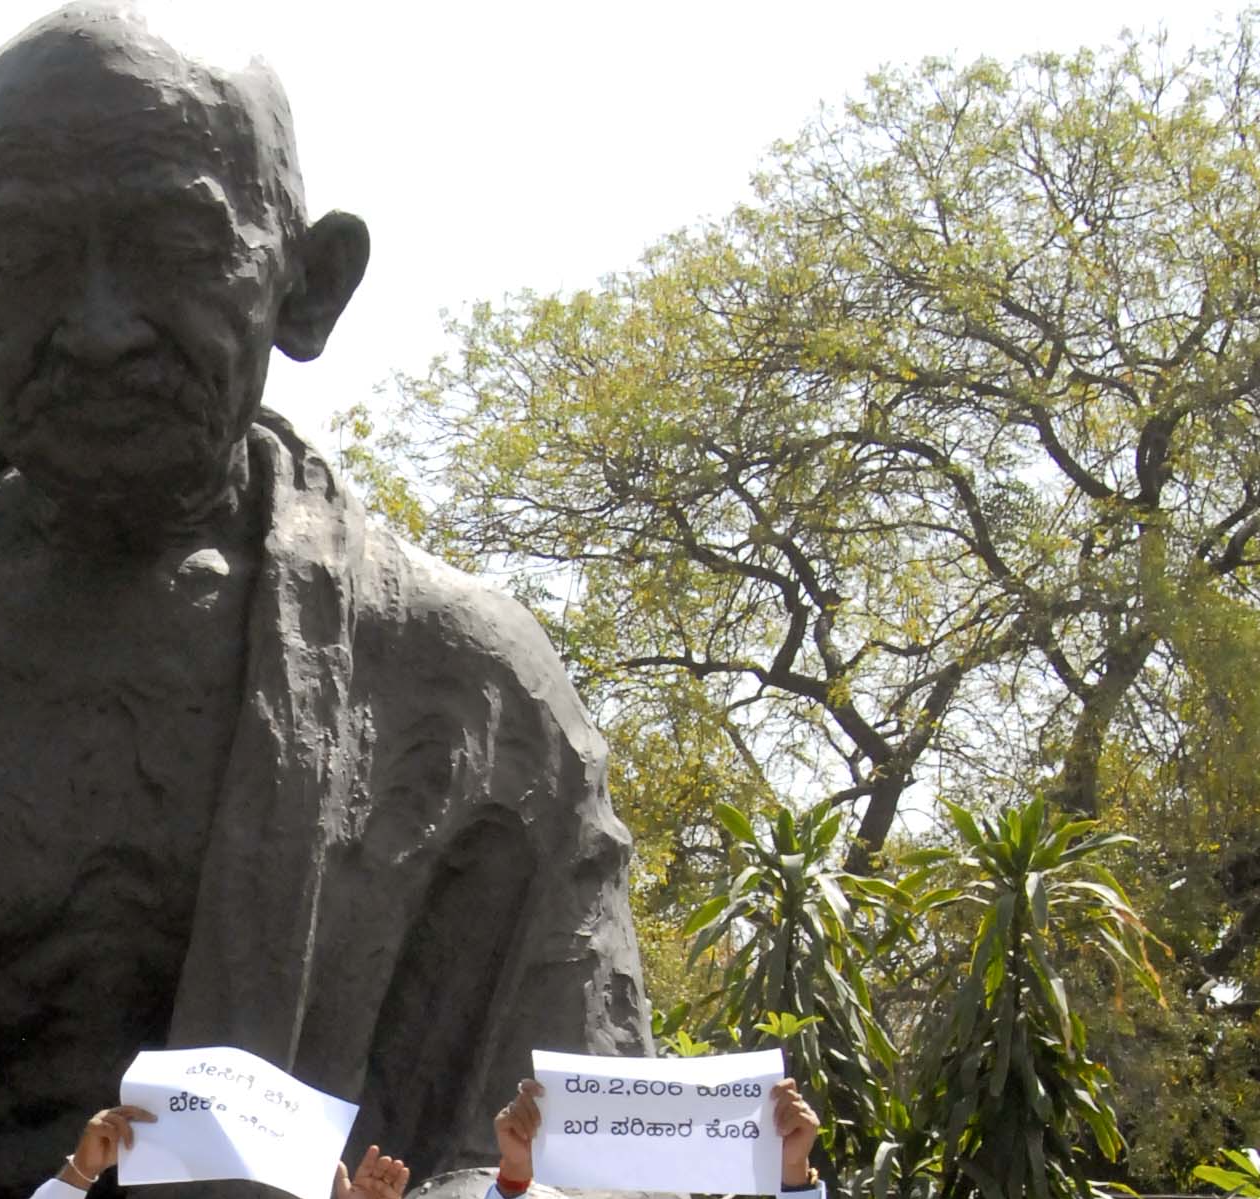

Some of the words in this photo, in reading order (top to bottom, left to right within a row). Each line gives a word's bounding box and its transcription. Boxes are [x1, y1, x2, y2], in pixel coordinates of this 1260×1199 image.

[563, 1116, 599, 1135] ಬರ
[611, 1116, 693, 1138] ಪರಿಹಾರ
[705, 1118, 760, 1139] ಕೊಡಿ
